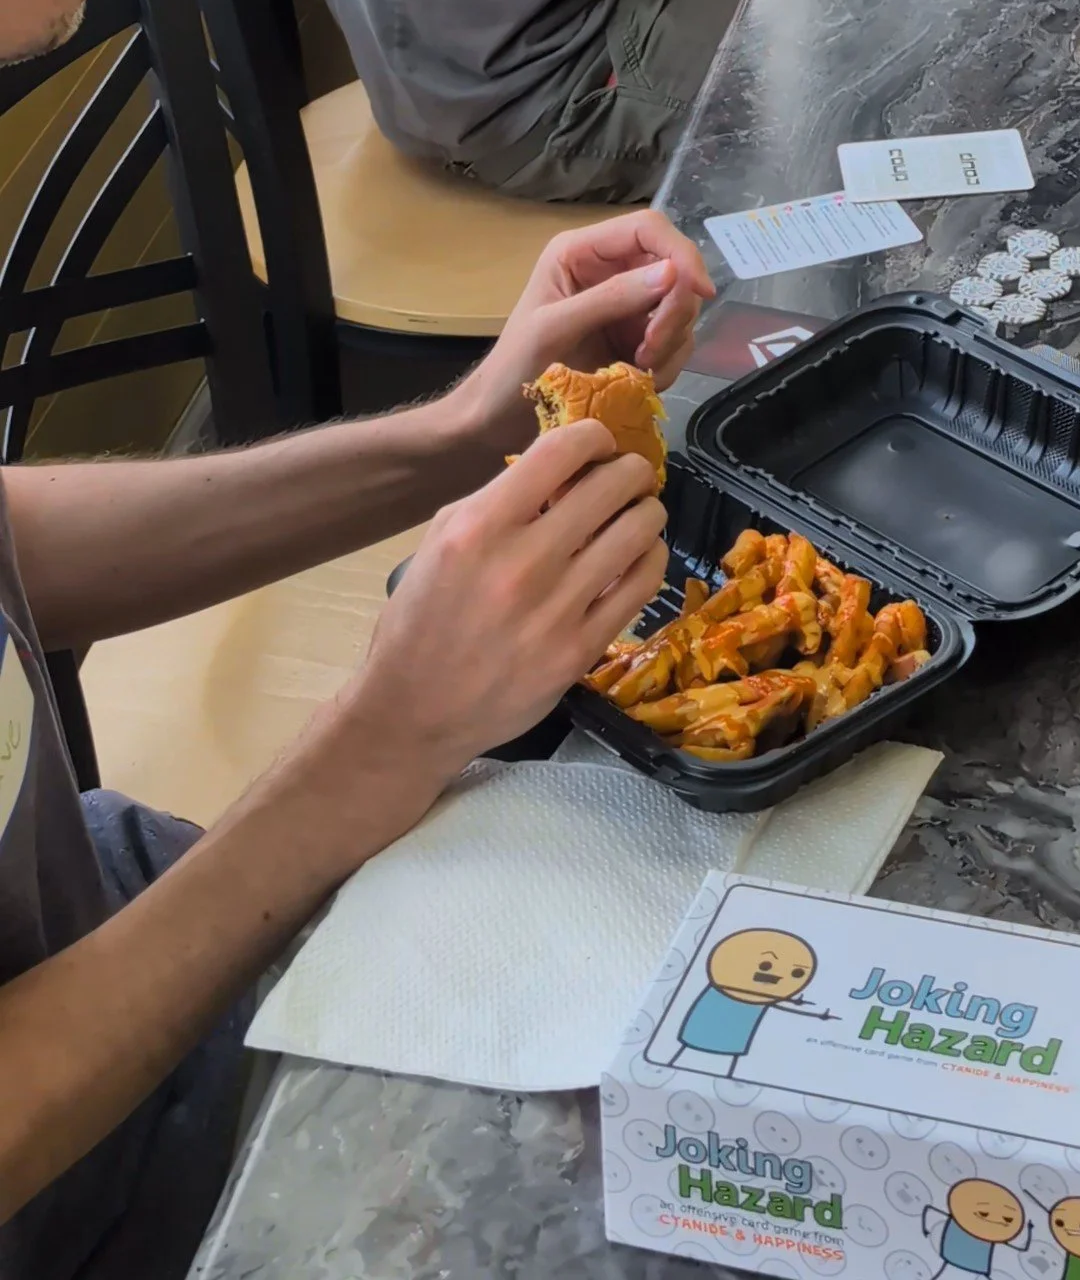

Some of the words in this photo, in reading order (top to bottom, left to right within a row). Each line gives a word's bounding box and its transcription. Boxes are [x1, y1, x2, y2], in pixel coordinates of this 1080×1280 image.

[848, 967, 1038, 1039] Joking
[858, 1005, 1063, 1076] Hazard
[941, 1062, 990, 1078] CYANIDE
[1006, 1075, 1070, 1094] HAPPINESS
[656, 1124, 813, 1195] Joking
[678, 1163, 843, 1230] Hazard
[680, 1204, 736, 1226] offensive
[741, 1217, 769, 1231] card
[773, 1225, 810, 1239] game
[814, 1230, 844, 1246] from
[659, 1214, 728, 1236] CYANIDE
[735, 1229, 746, 1241] &
[753, 1233, 844, 1261] HAPPINESS
